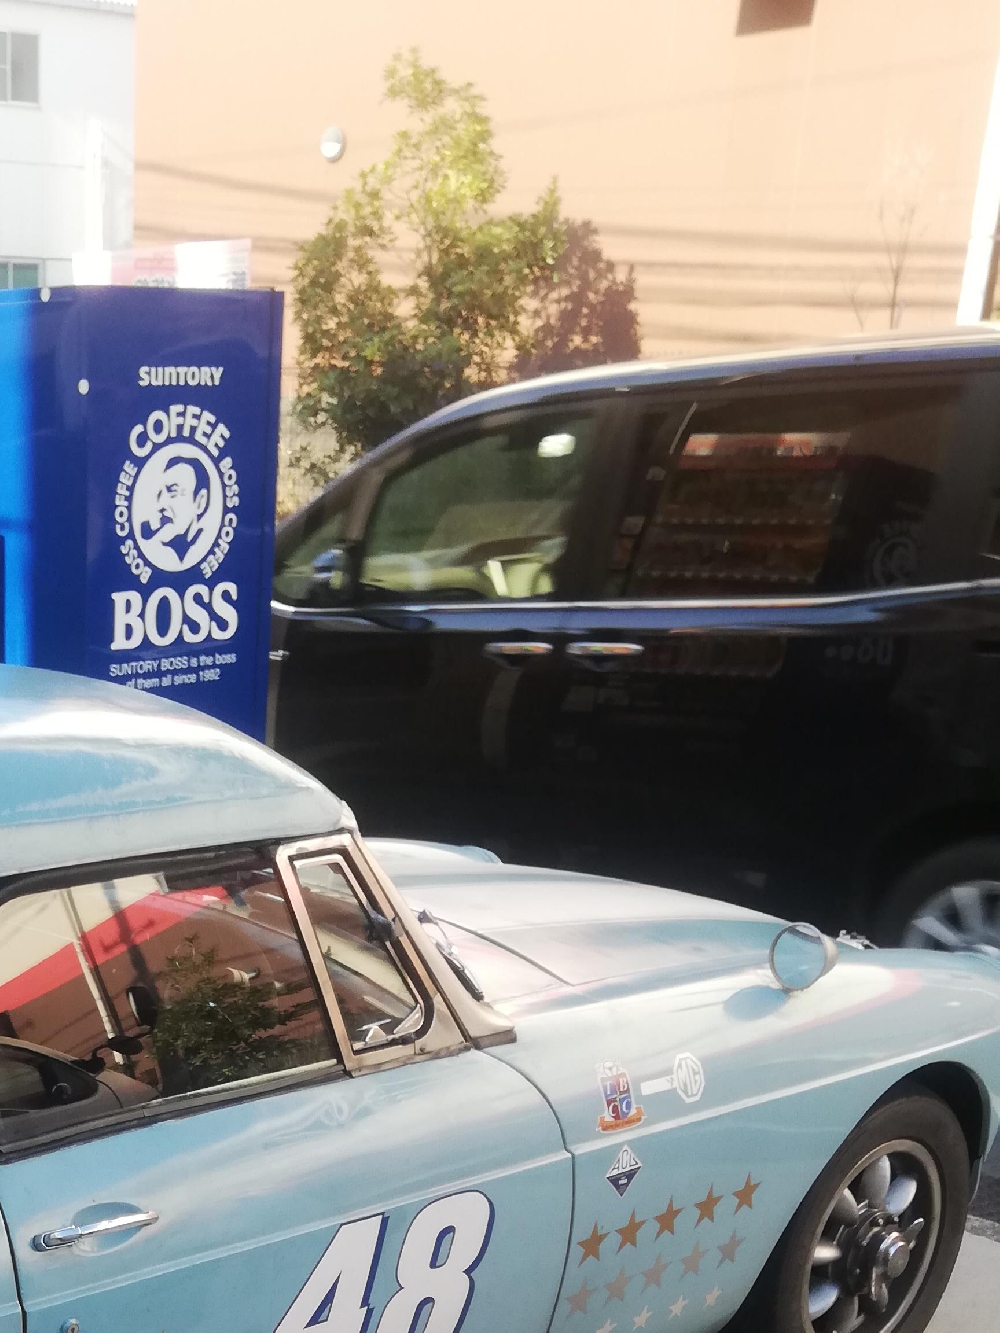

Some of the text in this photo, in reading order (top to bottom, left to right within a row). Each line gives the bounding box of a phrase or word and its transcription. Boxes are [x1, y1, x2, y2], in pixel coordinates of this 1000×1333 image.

[129, 404, 230, 458] COFFEE
[114, 460, 152, 584] BOSS COFFEE
[200, 456, 240, 580] BOSS COFFEE
[110, 582, 239, 651] BOSS
[109, 653, 237, 677] SUNTORY BOSS is the boss
[137, 678, 160, 689] them
[161, 675, 172, 687] all
[173, 673, 197, 685] since
